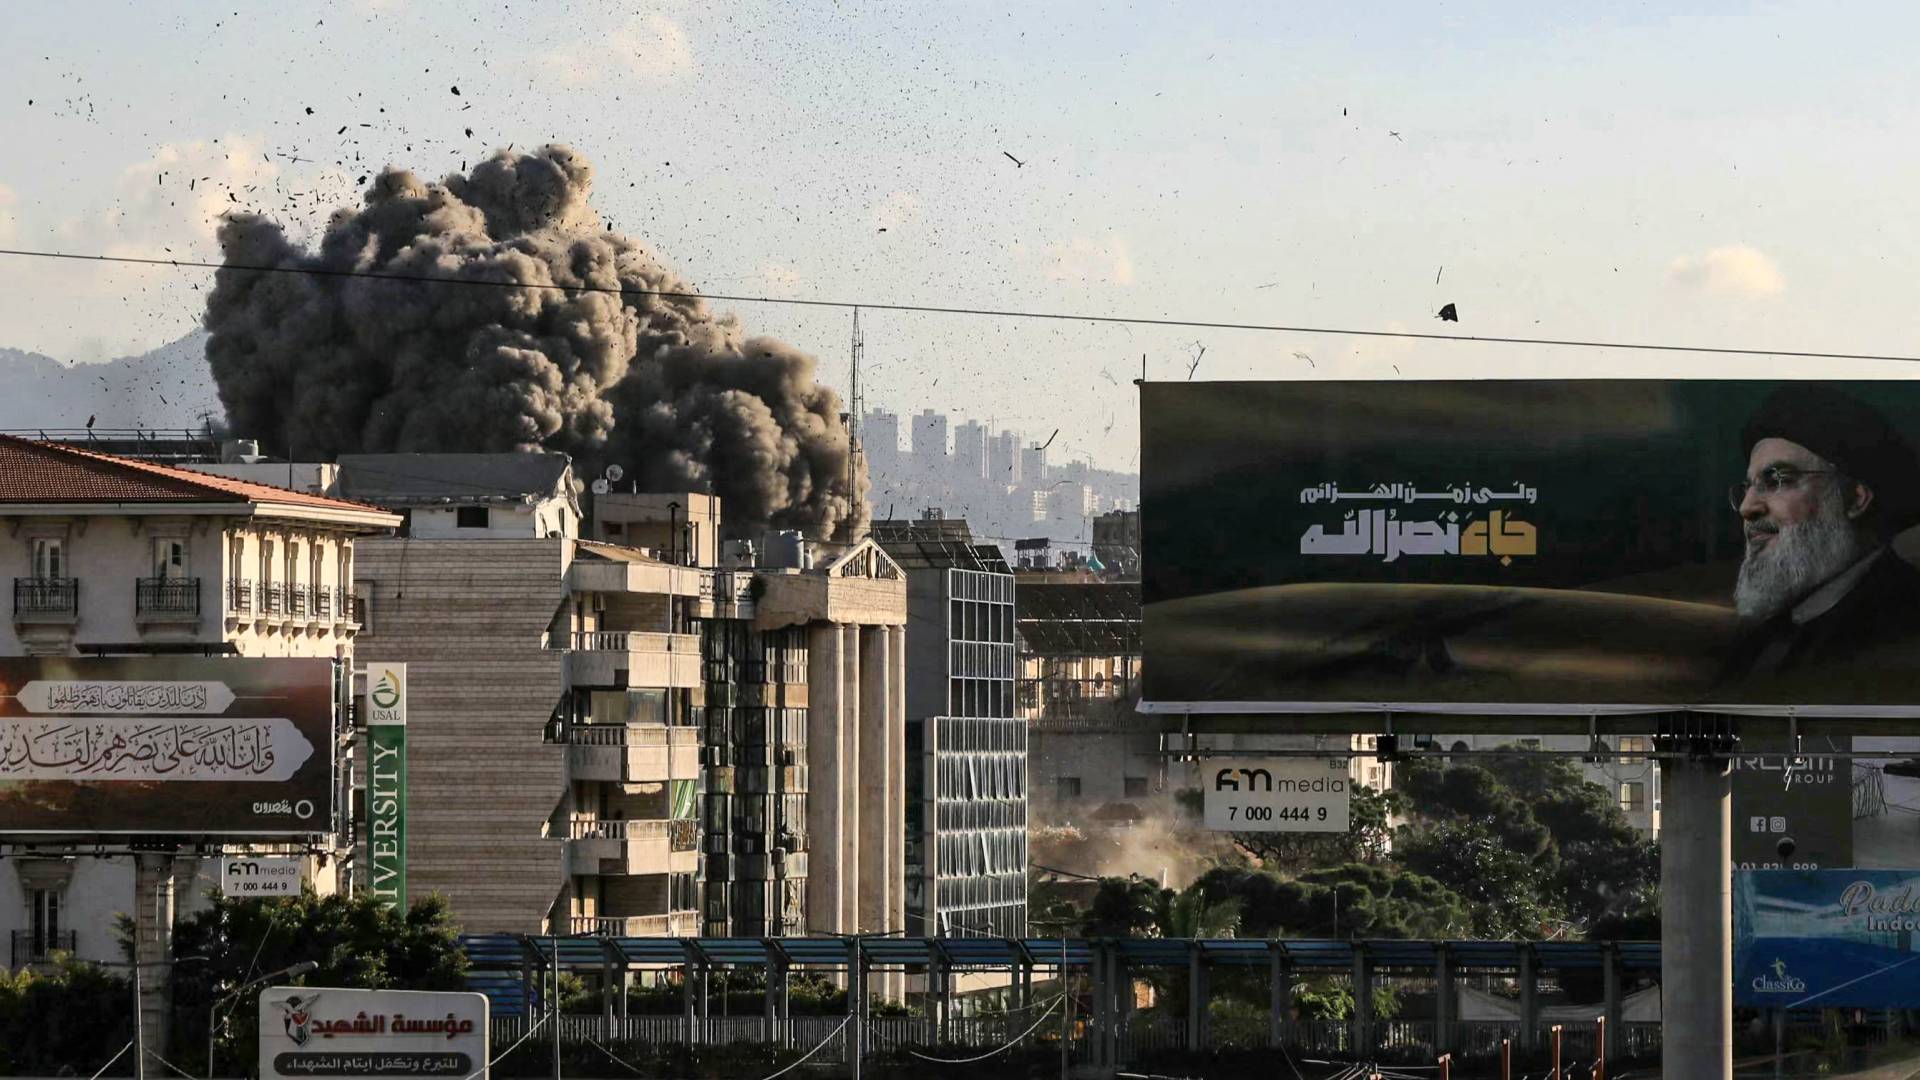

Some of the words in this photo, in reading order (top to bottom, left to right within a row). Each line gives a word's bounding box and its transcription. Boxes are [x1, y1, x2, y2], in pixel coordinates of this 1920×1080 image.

[372, 710, 400, 721] USAL
[1278, 777, 1344, 793] media
[1228, 806, 1238, 821] 7
[1245, 806, 1272, 821] 000
[1279, 806, 1310, 821] 444
[1317, 806, 1328, 821] 9
[260, 866, 296, 875] media
[234, 883, 240, 891] 7
[243, 882, 258, 891] 000
[261, 882, 278, 890] 444
[281, 882, 288, 890] 9
[1868, 915, 1920, 931] Indo
[310, 1009, 386, 1038] الشهيد
[391, 1012, 473, 1040] مؤسسة
[286, 1056, 341, 1073] الشهداء
[422, 1056, 458, 1076] للتبرع
